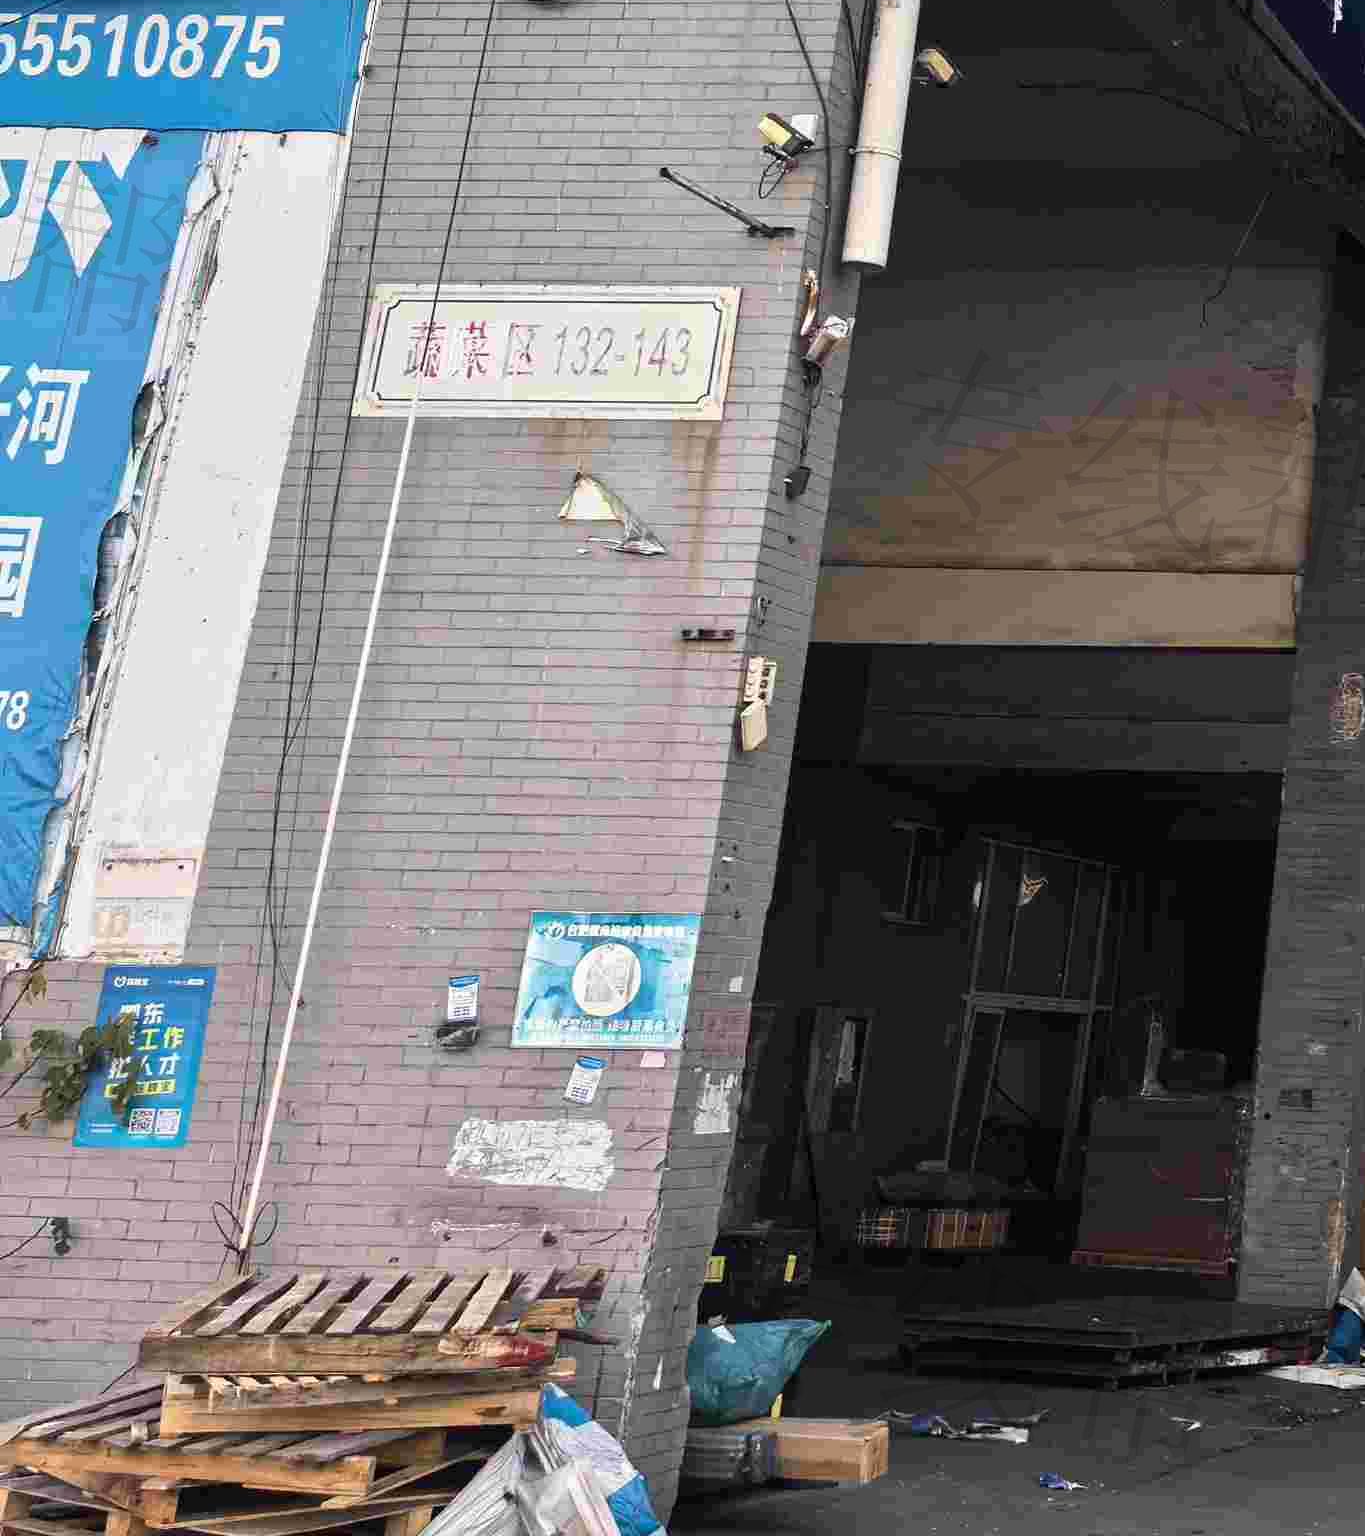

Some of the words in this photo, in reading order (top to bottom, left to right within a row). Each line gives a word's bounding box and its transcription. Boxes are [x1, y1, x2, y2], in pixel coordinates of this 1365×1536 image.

[403, 320, 545, 378] 蔬菜区
[552, 326, 693, 377] 132-143
[0, 363, 90, 465] 河
